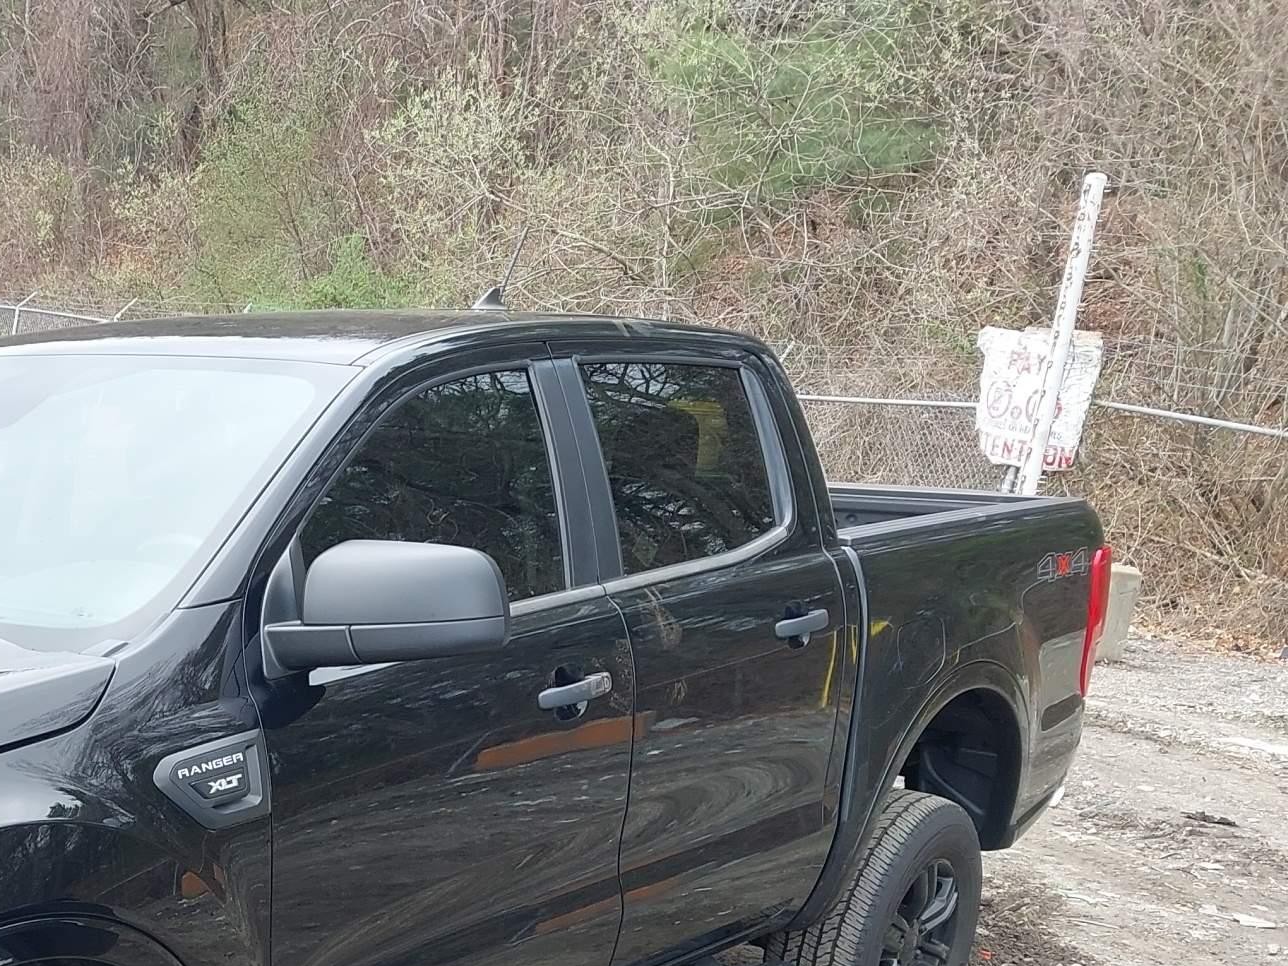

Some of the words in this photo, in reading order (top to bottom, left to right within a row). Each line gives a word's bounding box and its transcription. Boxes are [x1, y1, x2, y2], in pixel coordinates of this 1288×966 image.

[981, 432, 1075, 468] TENTON
[178, 752, 244, 779] RANGER
[209, 774, 243, 794] XLT
